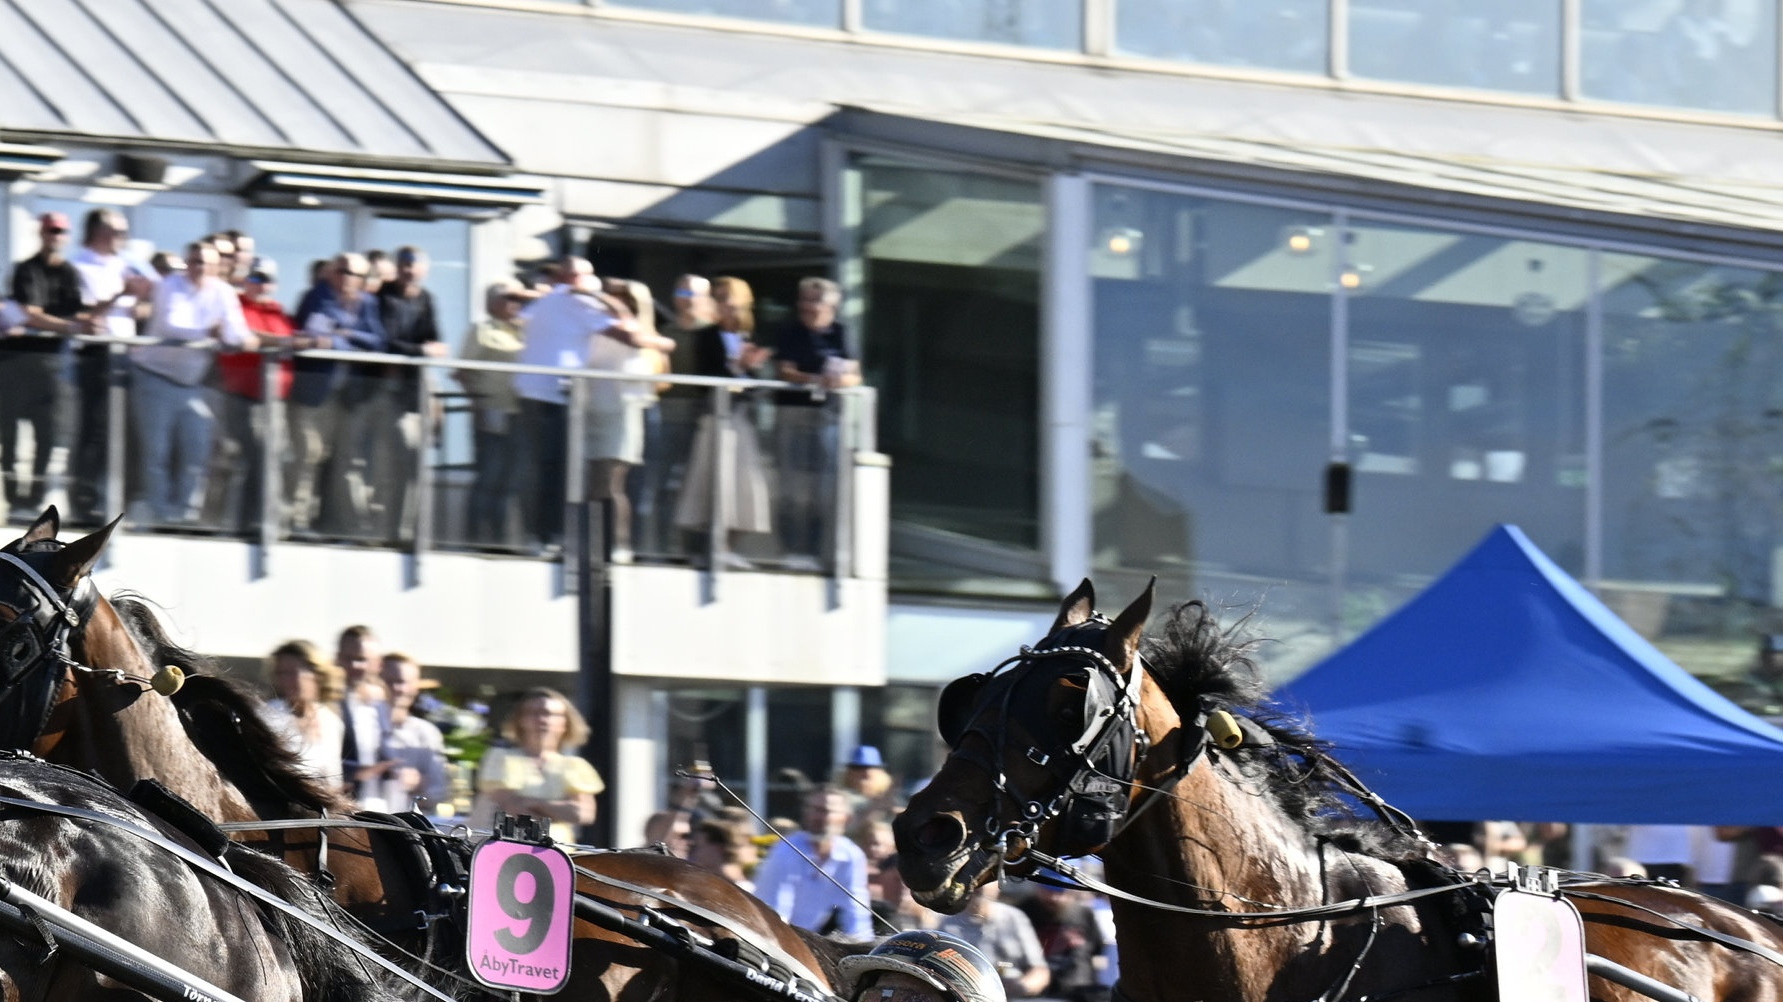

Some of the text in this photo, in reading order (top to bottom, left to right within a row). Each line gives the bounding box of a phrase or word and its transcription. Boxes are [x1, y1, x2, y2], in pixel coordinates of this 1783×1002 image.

[494, 853, 555, 955] 9
[480, 949, 560, 980] ÅbyTravet
[746, 967, 785, 993] David
